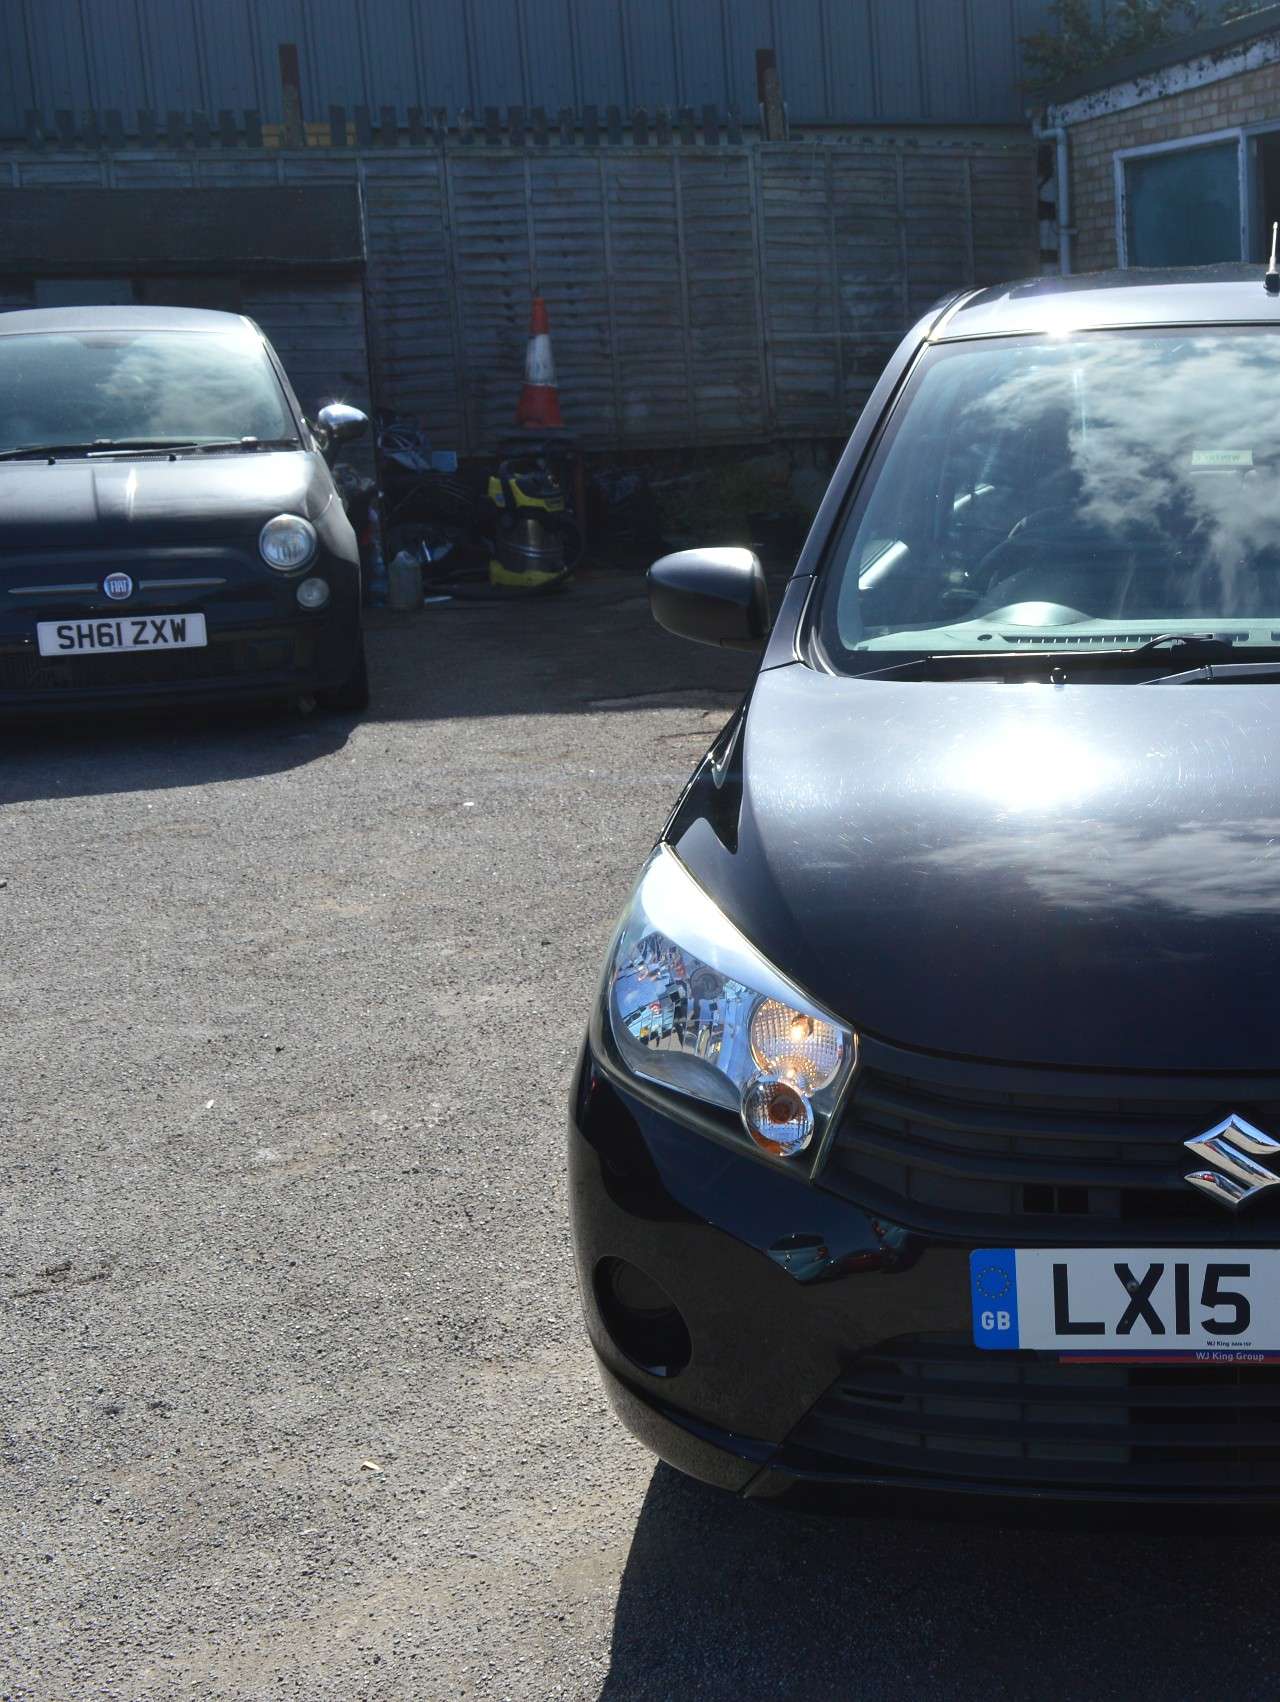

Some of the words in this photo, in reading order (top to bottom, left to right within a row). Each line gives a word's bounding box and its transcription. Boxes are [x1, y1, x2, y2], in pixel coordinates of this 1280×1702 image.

[110, 580, 128, 593] FIAT
[57, 621, 124, 650] SH61
[131, 618, 187, 646] ZXW
[1052, 1263, 1251, 1336] LX15
[981, 1311, 1010, 1330] GB
[1196, 1352, 1210, 1360] WJ
[1213, 1352, 1233, 1361] King
[1236, 1352, 1264, 1361] Group
